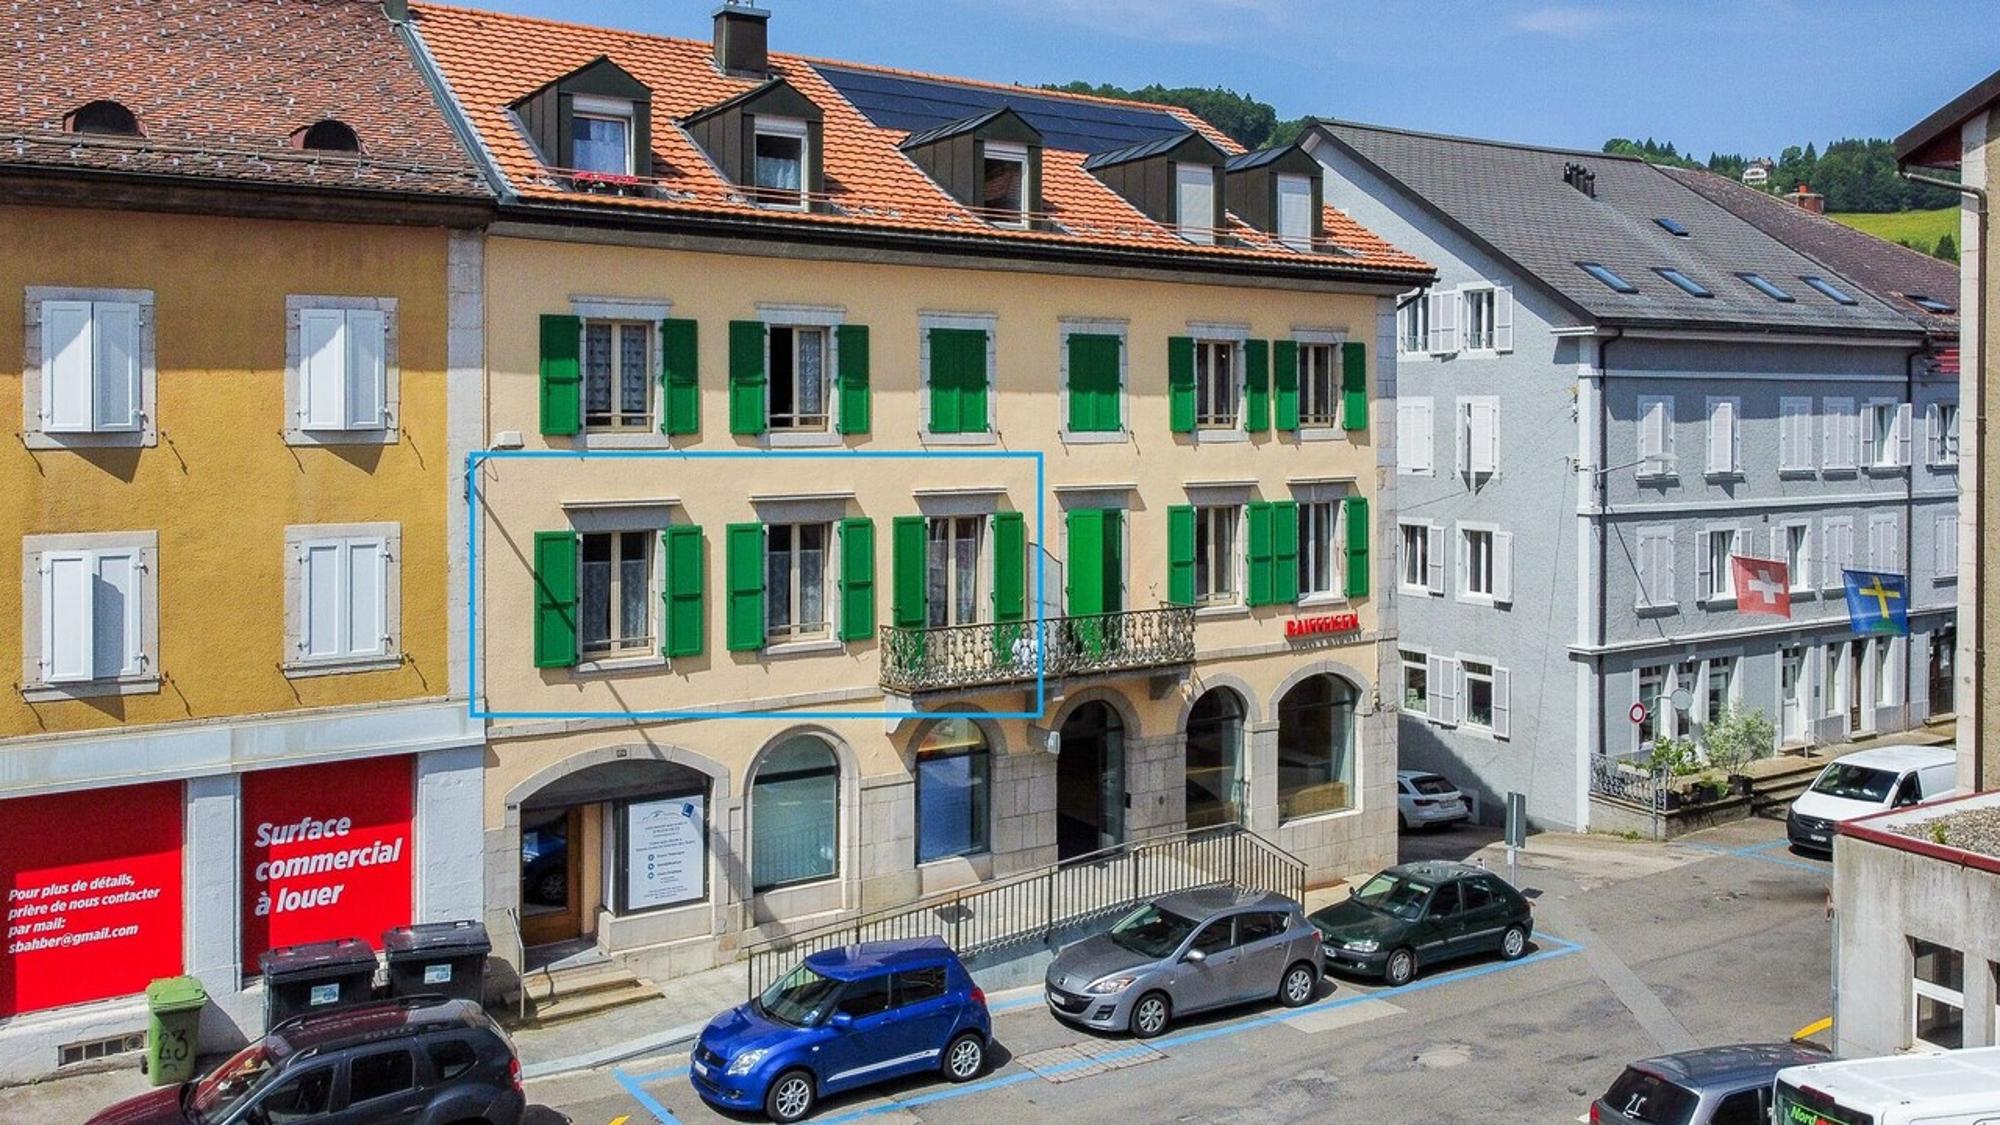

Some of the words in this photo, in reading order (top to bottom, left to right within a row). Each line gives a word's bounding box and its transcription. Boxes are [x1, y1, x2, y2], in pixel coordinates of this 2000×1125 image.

[254, 816, 352, 848] Surface
[255, 837, 403, 882] commercial
[8, 888, 40, 902] Pour
[41, 883, 69, 899] plus
[71, 880, 88, 894] de
[90, 874, 136, 890] détails,
[8, 904, 48, 921] prière
[50, 901, 67, 914] de
[69, 897, 100, 910] nous
[102, 887, 161, 905] contacter
[254, 891, 272, 916] à
[276, 884, 345, 914] louer
[8, 924, 32, 938] par
[33, 917, 66, 933] mail:
[8, 925, 139, 954] sbahber@gmail.com
[158, 1028, 189, 1062] 23
